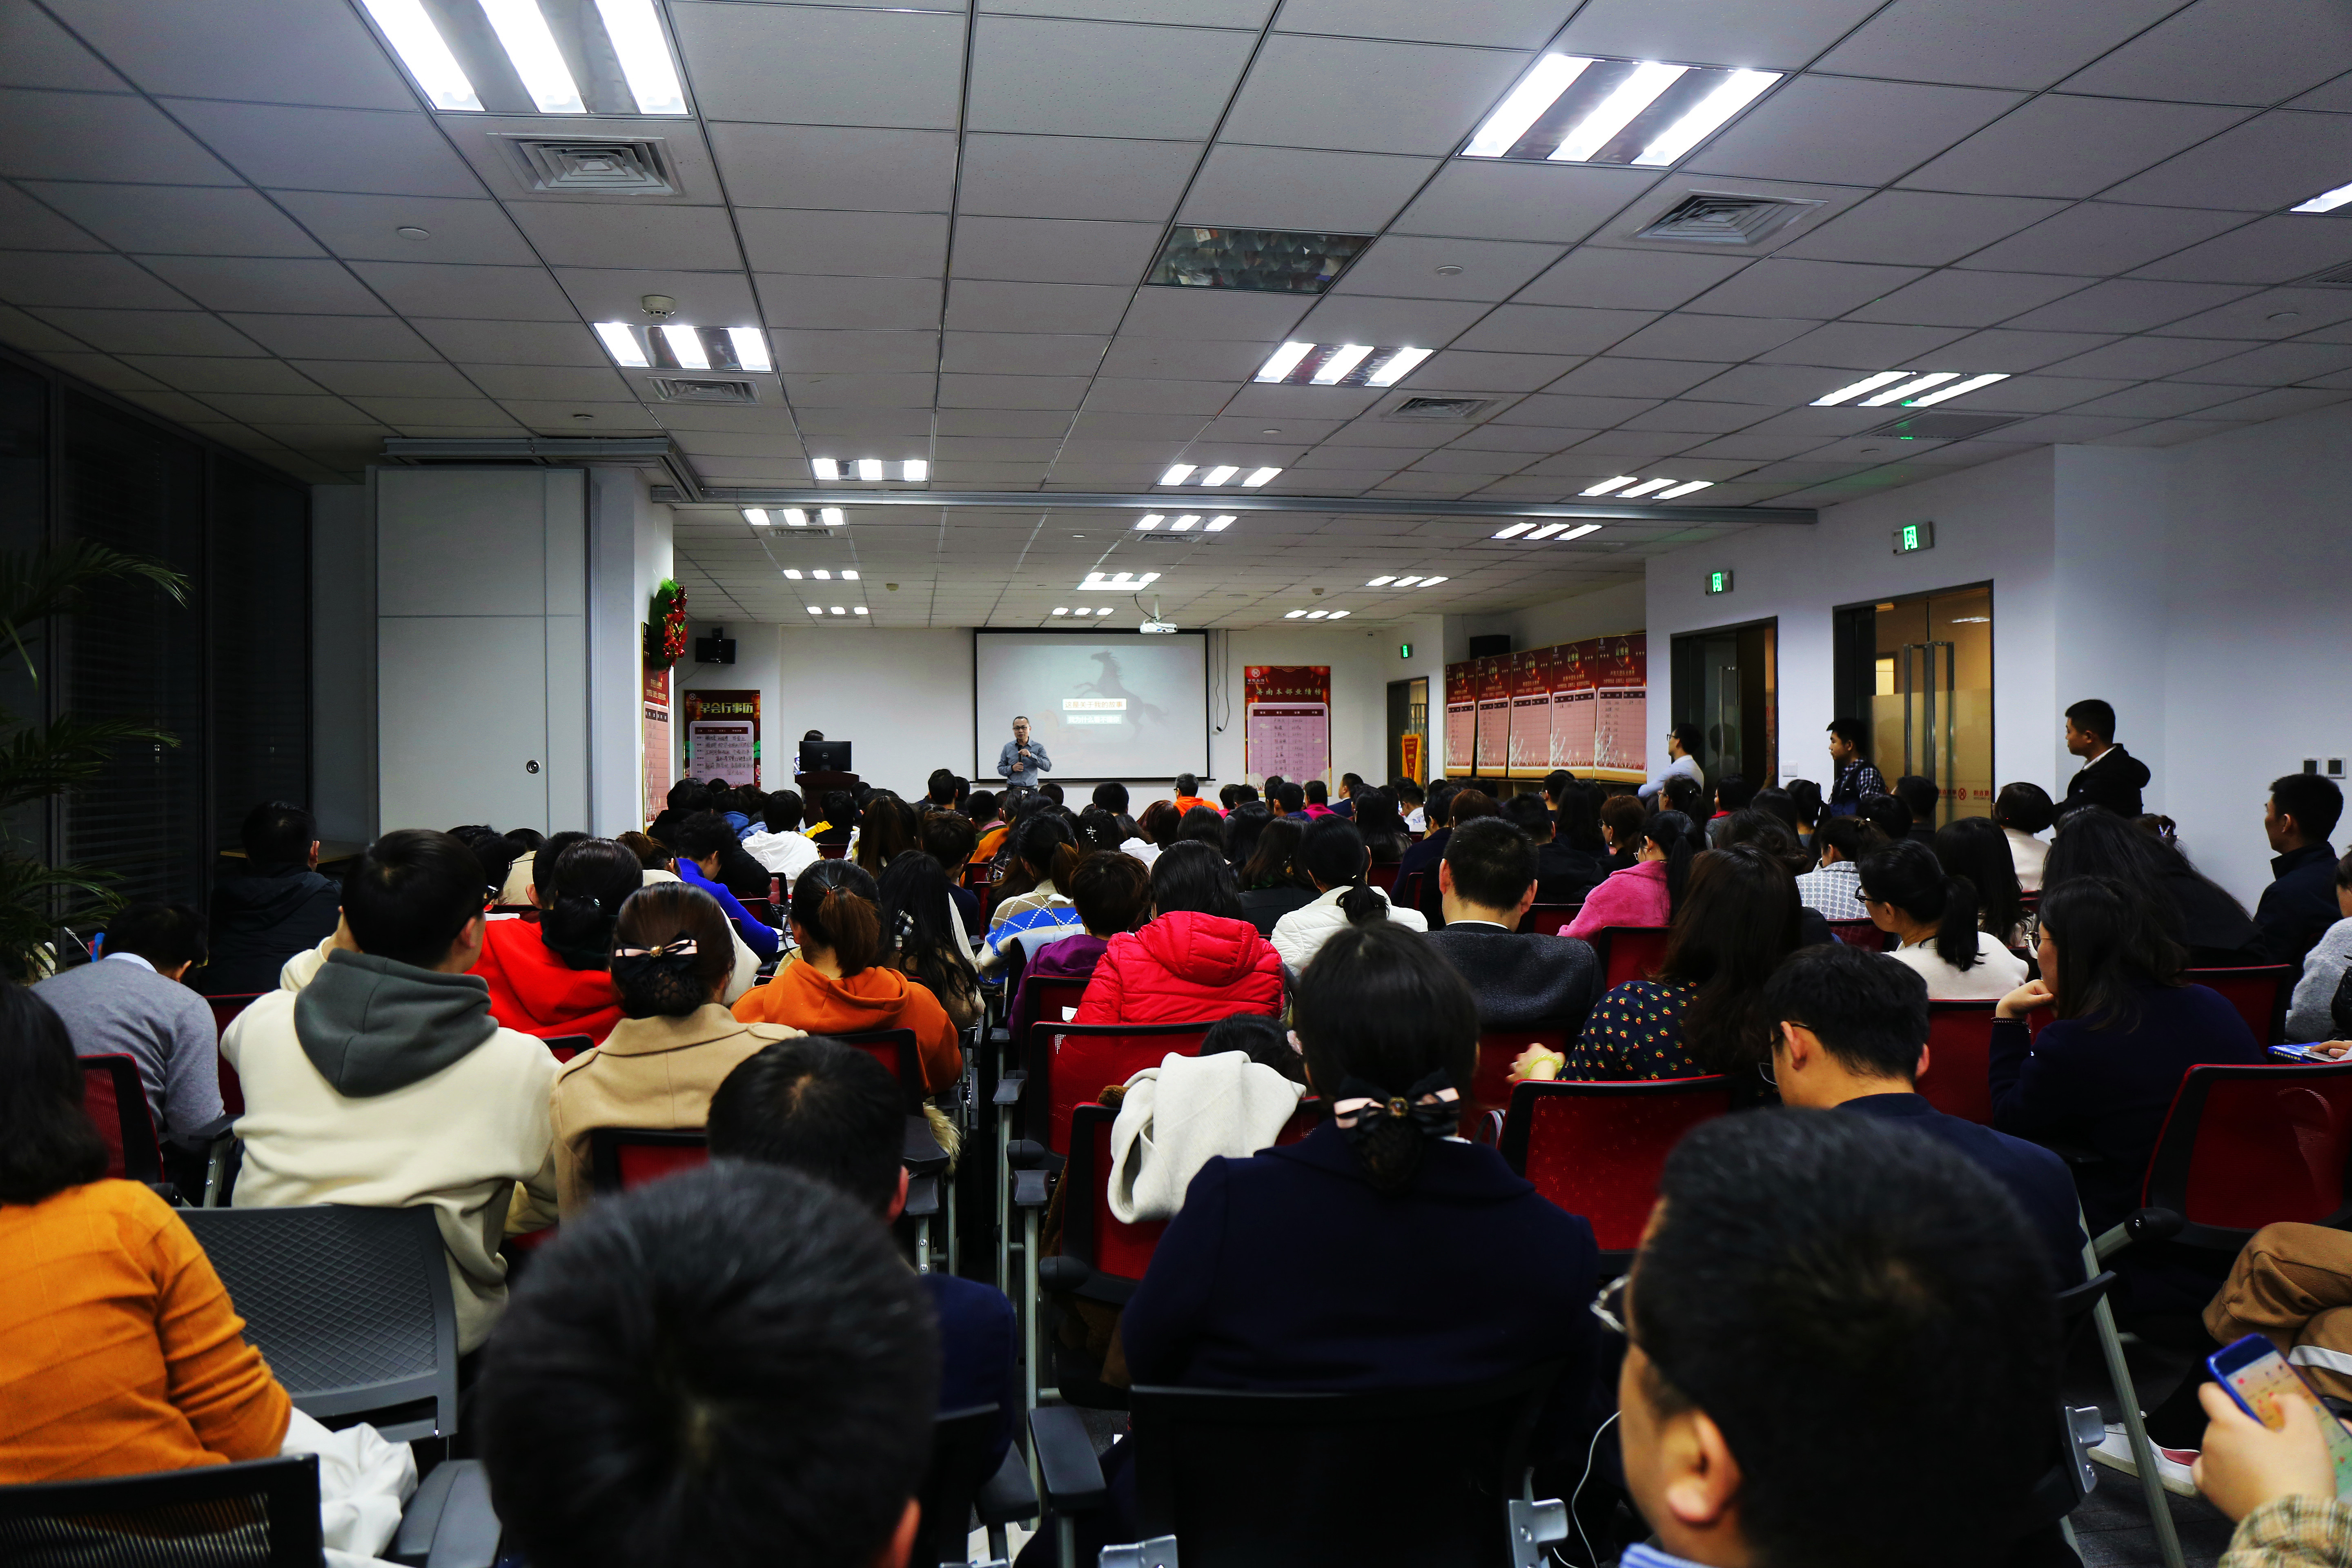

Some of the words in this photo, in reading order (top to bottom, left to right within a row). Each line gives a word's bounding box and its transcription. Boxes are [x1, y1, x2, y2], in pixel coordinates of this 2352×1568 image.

[1256, 688, 1321, 696] 济南本部业绩榜
[700, 703, 753, 713] 早会行事历
